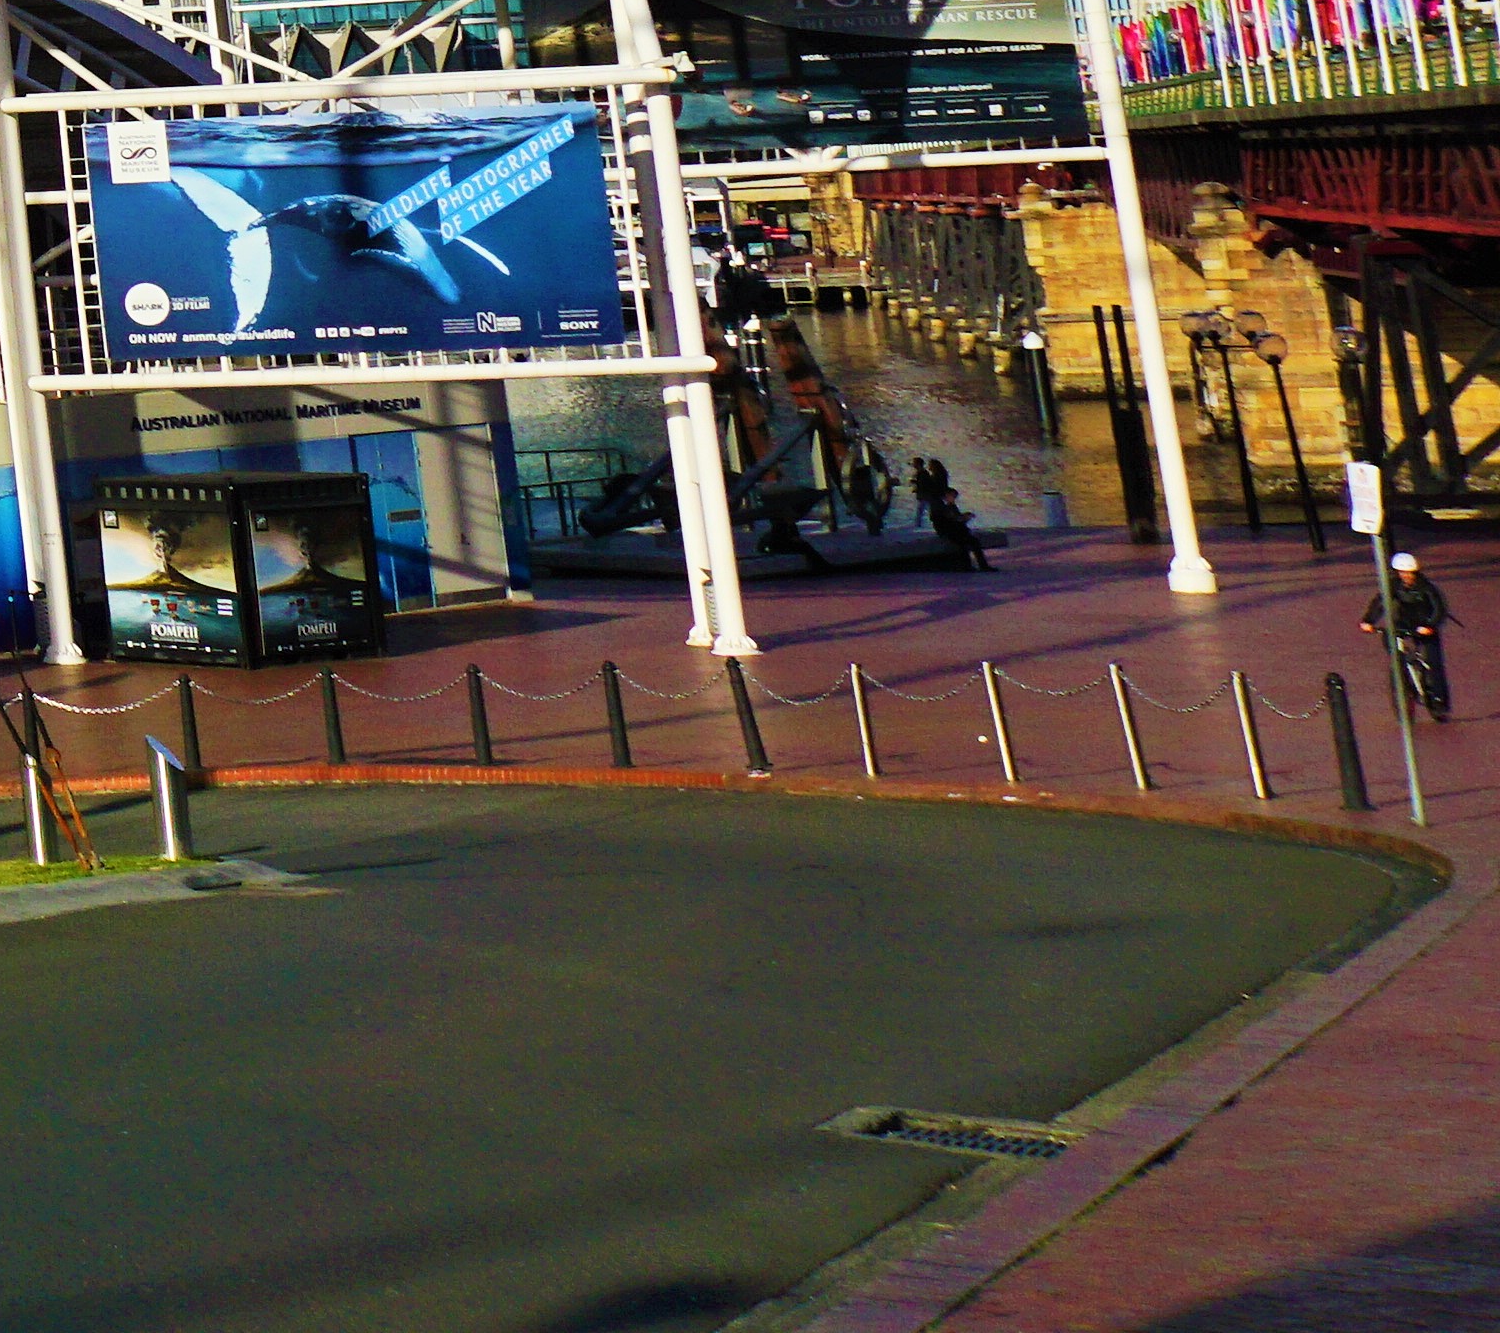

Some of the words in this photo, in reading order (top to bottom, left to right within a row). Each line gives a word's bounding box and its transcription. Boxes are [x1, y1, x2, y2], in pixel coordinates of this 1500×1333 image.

[974, 8, 1037, 21] RESCUE
[966, 46, 974, 54] A
[437, 119, 575, 215] PHOTOGRAPHER
[367, 169, 452, 232] WILDLIFE
[440, 213, 463, 240] OF
[467, 190, 505, 221] THE
[506, 160, 552, 198] YEAR
[559, 320, 600, 331] SONY
[128, 333, 147, 344] ON
[150, 332, 178, 344] NOW
[131, 411, 221, 432] AUSTRALIAN
[222, 408, 292, 426] NATIONAL
[296, 402, 362, 420] MARITIME
[362, 397, 421, 413] MUSEUM
[150, 622, 199, 640] POMPEII
[297, 622, 337, 637] POMPEII
